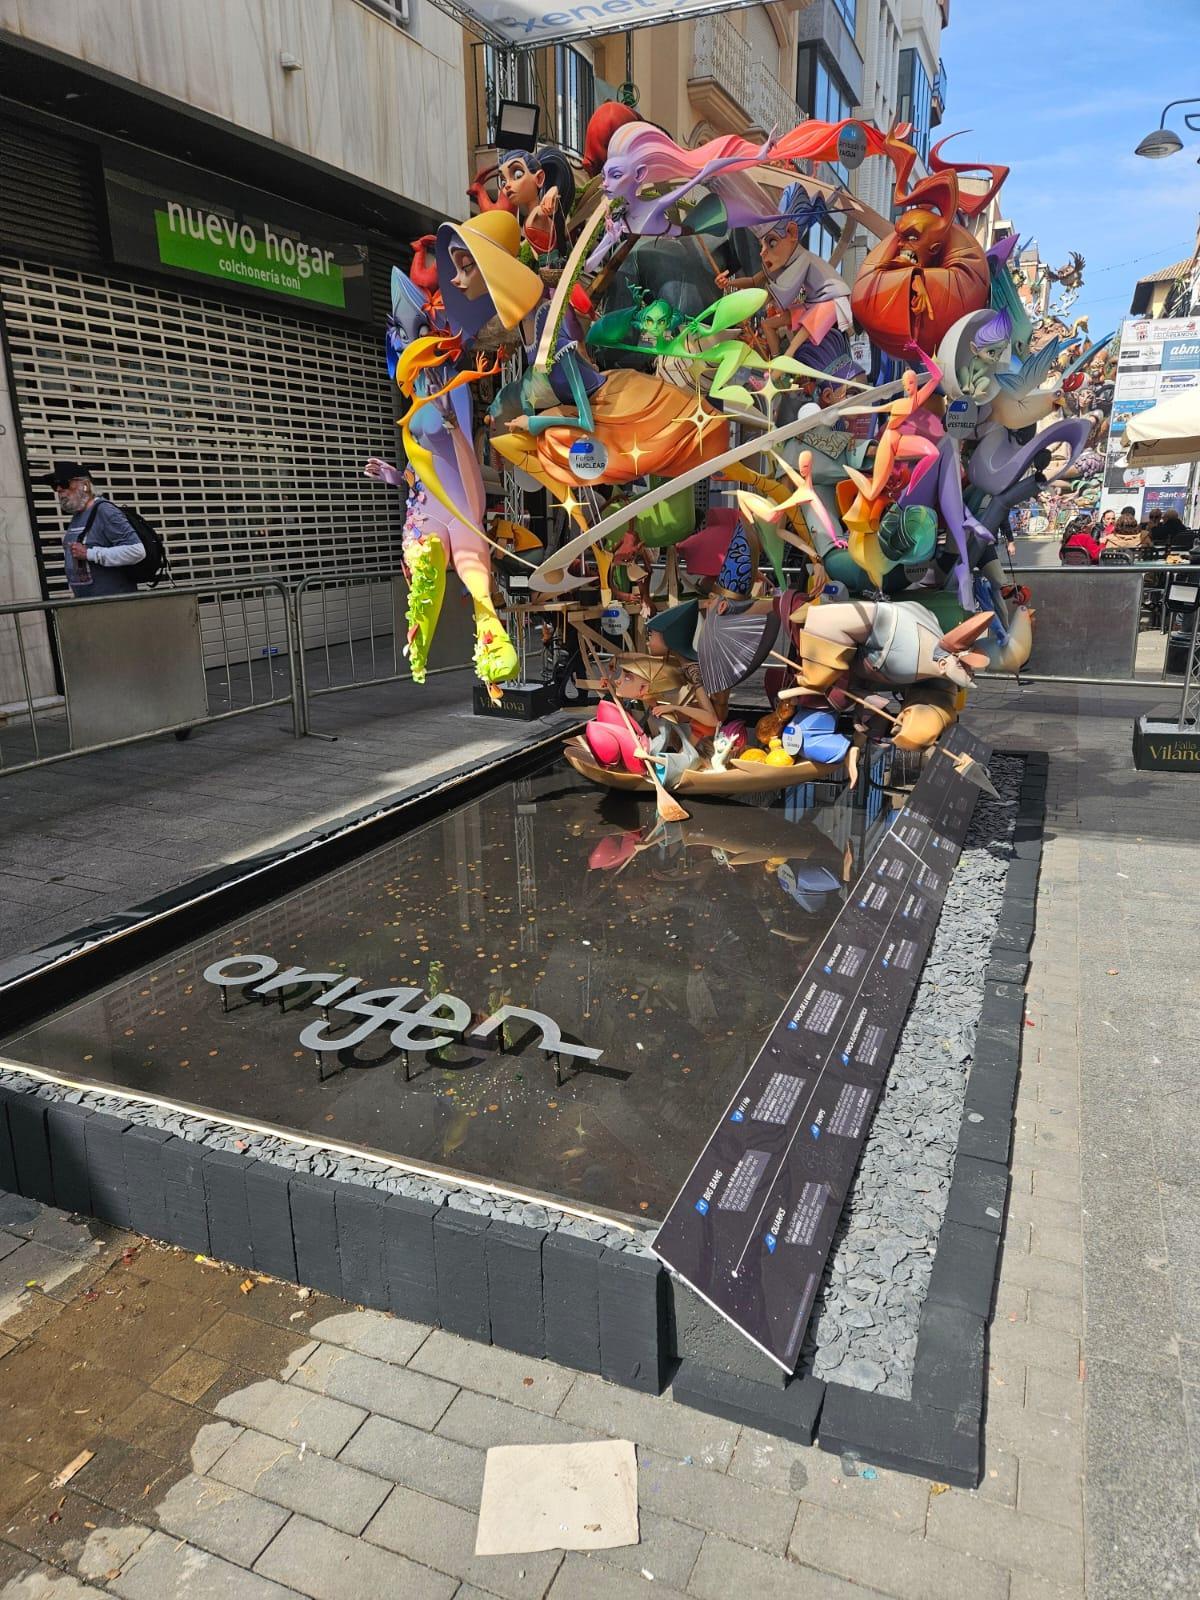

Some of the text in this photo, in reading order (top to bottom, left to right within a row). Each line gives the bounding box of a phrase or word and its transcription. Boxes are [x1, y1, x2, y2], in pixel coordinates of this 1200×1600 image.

[167, 201, 335, 278] nuevo hogar
[218, 257, 301, 290] colchonería toni
[480, 697, 525, 711] Vilnova
[203, 954, 604, 1060] origen
[702, 1169, 723, 1202] BIG BANG
[770, 1208, 786, 1236] QUARKS
